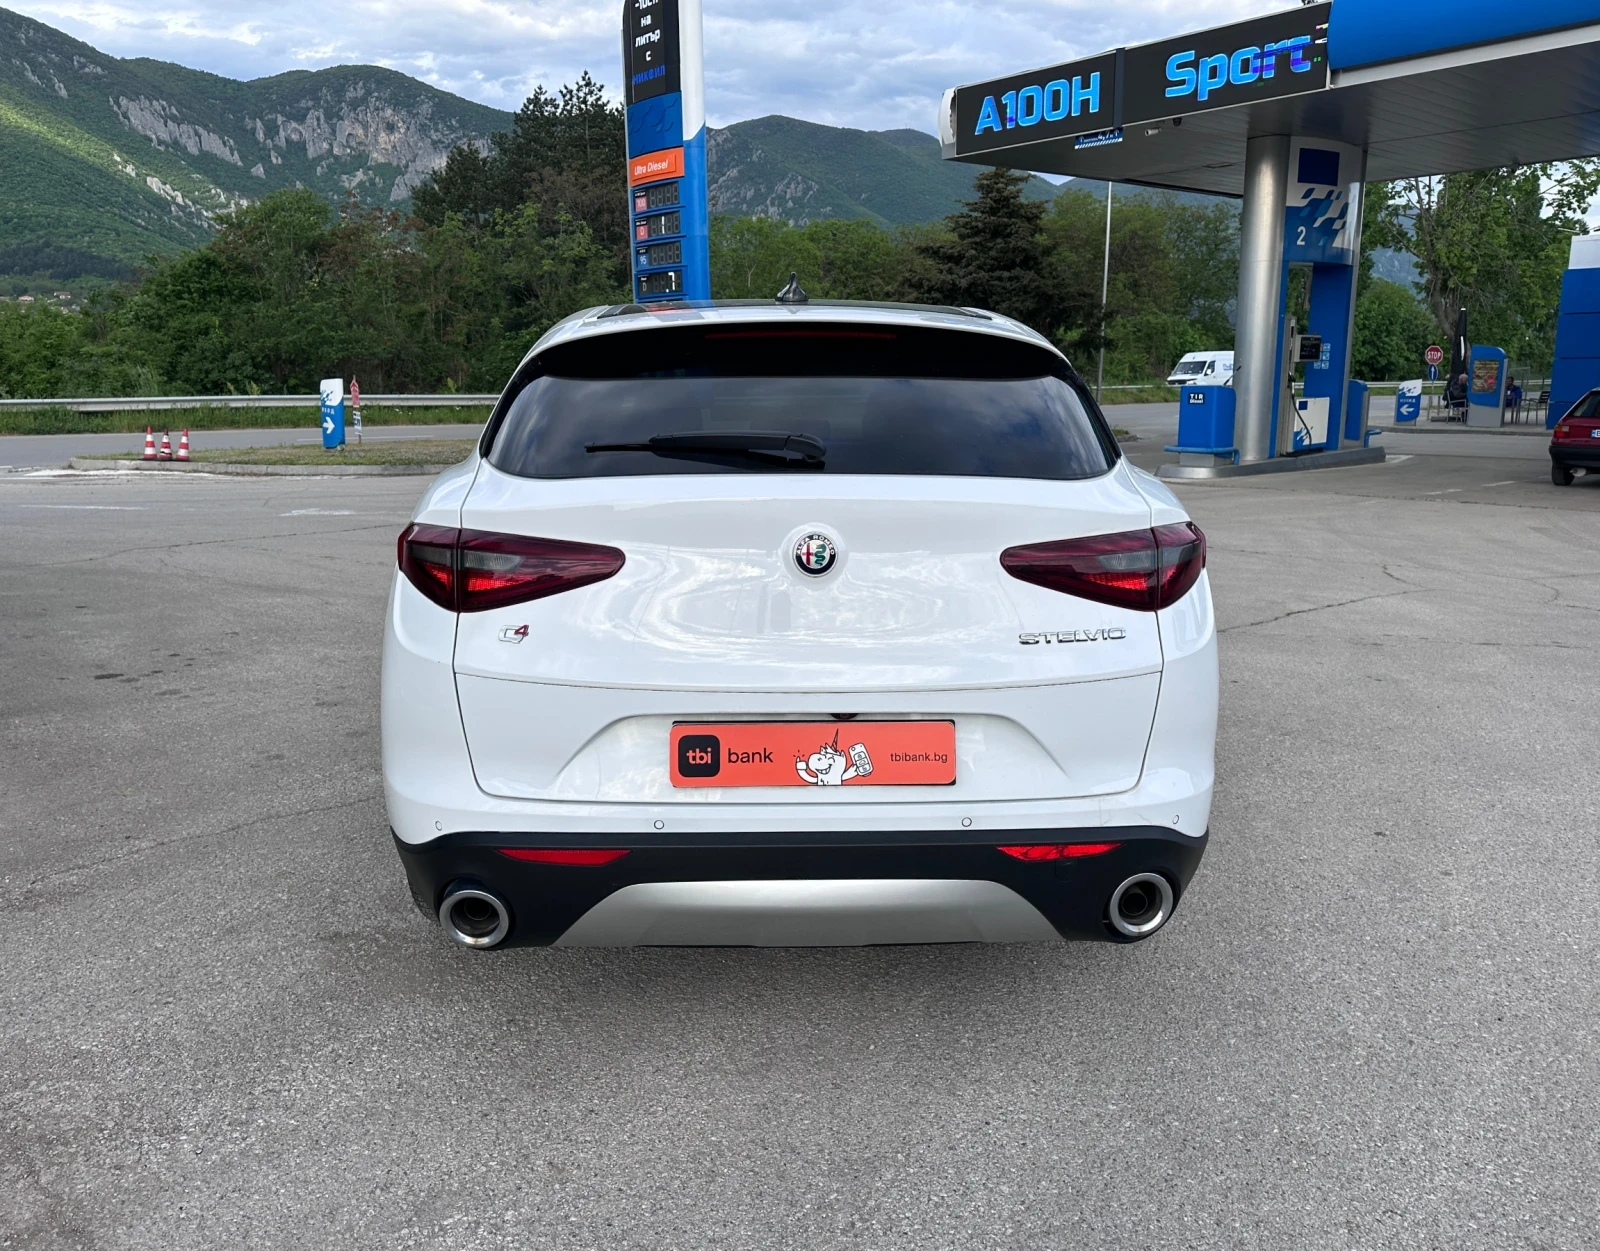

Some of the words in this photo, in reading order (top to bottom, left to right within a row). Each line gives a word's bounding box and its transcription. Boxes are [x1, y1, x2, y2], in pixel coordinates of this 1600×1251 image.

[640, 14, 651, 27] на
[635, 29, 660, 48] литър
[1165, 35, 1311, 101] Sport
[974, 72, 1100, 136] A100H
[634, 164, 647, 176] Ultra
[647, 158, 669, 173] Diesel
[1296, 225, 1306, 246] 2
[1427, 351, 1441, 360] STOP
[796, 536, 811, 556] ALFA
[812, 534, 836, 556] ROMEO
[1018, 627, 1127, 645] STELVIO
[686, 747, 713, 765] tbi
[727, 747, 774, 764] bank
[889, 752, 949, 764] tbibank.bg
